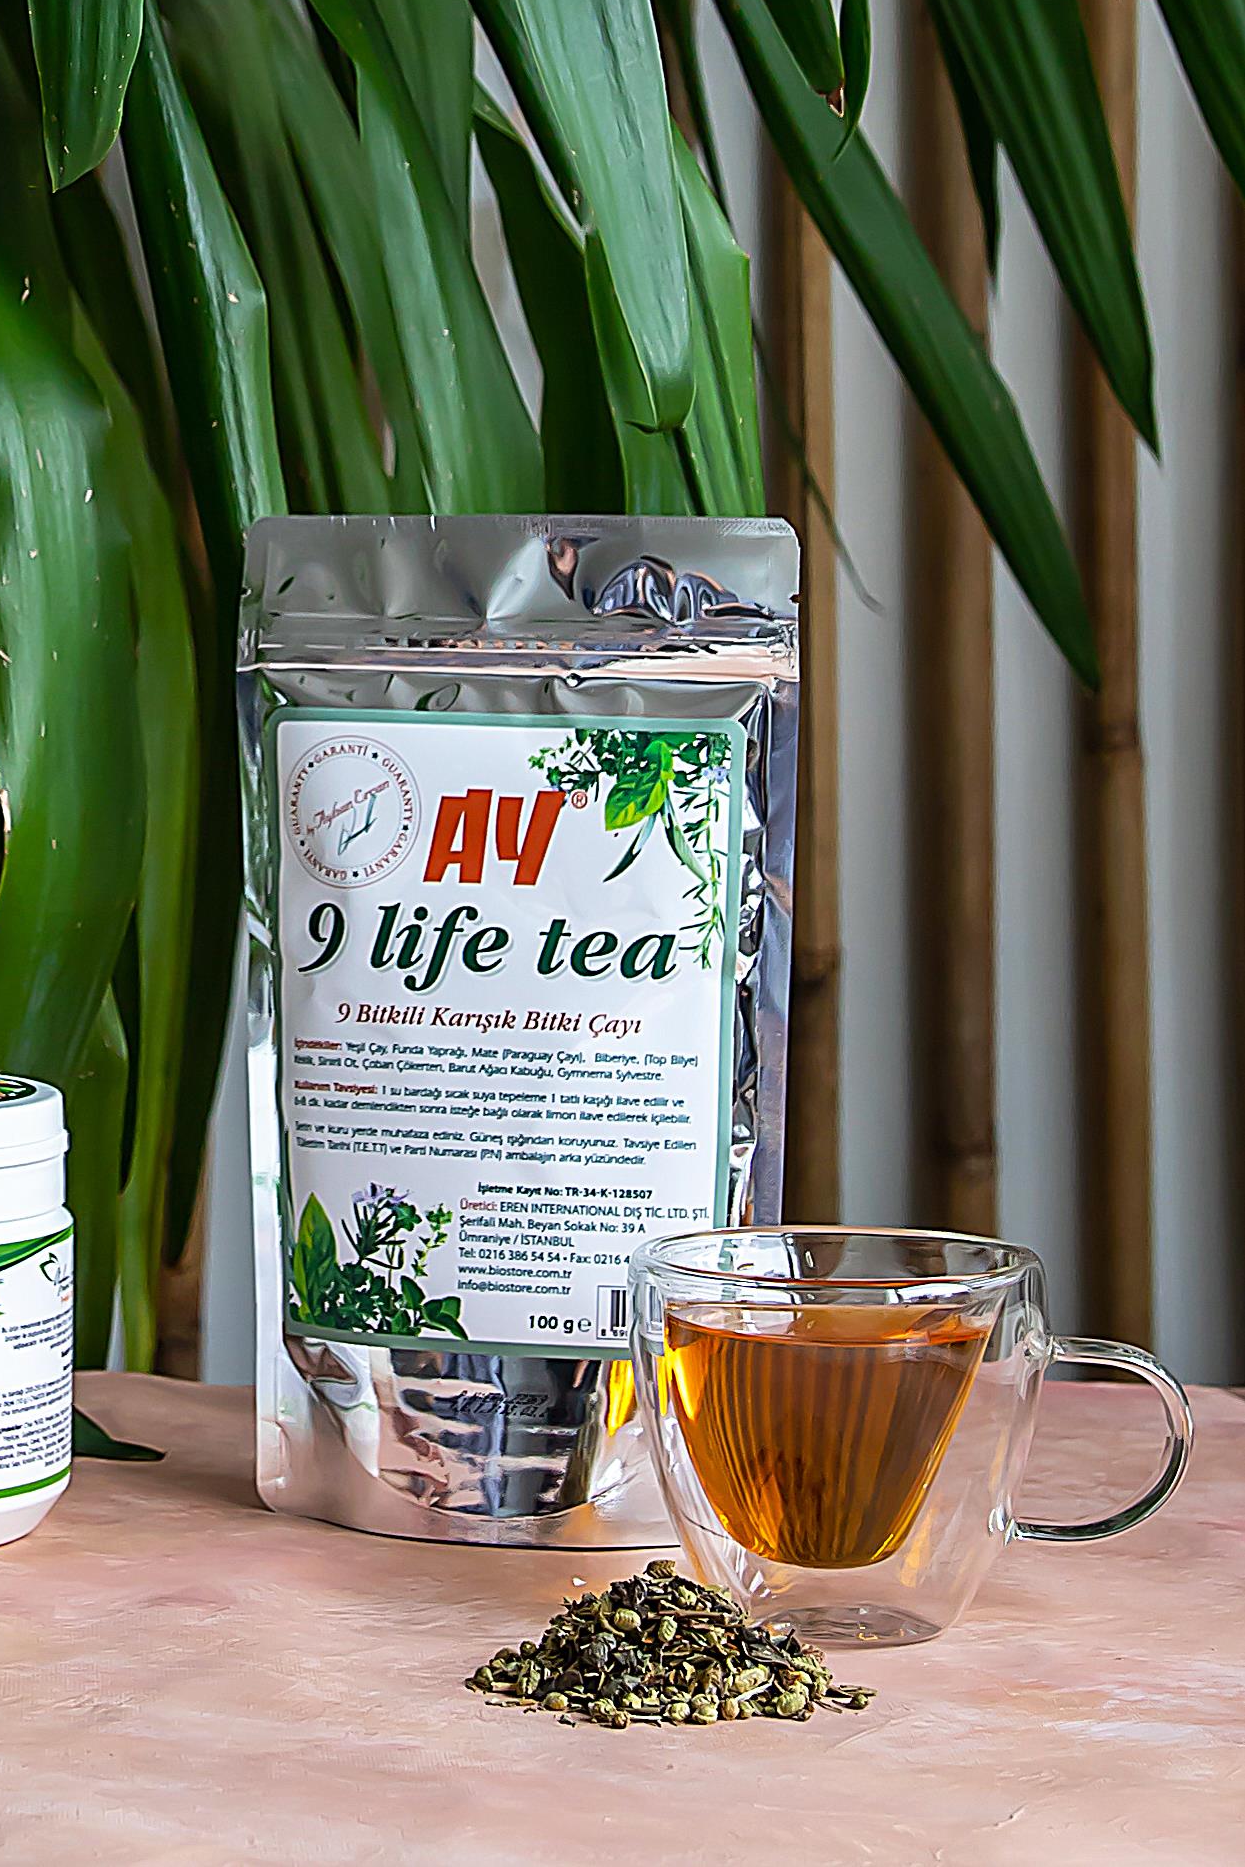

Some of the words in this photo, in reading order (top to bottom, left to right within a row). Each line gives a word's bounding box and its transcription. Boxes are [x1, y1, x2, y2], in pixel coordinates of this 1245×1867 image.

[423, 788, 567, 886] AY
[298, 902, 346, 974] 9
[369, 902, 510, 993] life
[536, 918, 680, 981] tea
[334, 1003, 351, 1023] 9
[356, 1004, 425, 1025] Bitkili
[430, 1006, 516, 1033] Karışık
[523, 1010, 582, 1032] Bitki
[588, 1013, 641, 1039] Çayı
[392, 1043, 424, 1054] Funda
[472, 1048, 499, 1058] Mate
[502, 1048, 553, 1063] (Paraguay
[362, 1058, 394, 1071] Çoban
[449, 1062, 476, 1073] Barut
[479, 1063, 507, 1077] Ağacı
[511, 1065, 553, 1079] Kabuğu,
[558, 1067, 612, 1080] Gymnema
[404, 1087, 442, 1100] bardağı
[473, 1091, 496, 1102] suya
[672, 1099, 684, 1107] ve
[419, 1105, 447, 1114] sonra
[511, 1108, 543, 1119] olarak
[546, 1109, 576, 1120] limon
[470, 1131, 503, 1146] Güneş
[623, 1138, 660, 1151] Tavsiye
[664, 1139, 696, 1150] Edilen
[389, 1146, 401, 1154] ve
[429, 1146, 477, 1158] Numarası
[559, 1153, 581, 1162] arka
[544, 1186, 563, 1196] No:
[565, 1186, 652, 1199] TR-34-K-128507
[500, 1201, 528, 1213] EREN
[531, 1203, 620, 1217] INTERNATIONAL
[624, 1206, 642, 1220] DIŞ
[668, 1208, 689, 1219] LTD.
[498, 1218, 524, 1229] Mah.
[527, 1219, 561, 1232] Beyan
[564, 1220, 597, 1232] Sokak
[600, 1222, 618, 1232] No:
[621, 1223, 635, 1233] 39
[638, 1224, 646, 1233] A
[459, 1230, 511, 1246] Ümraniye
[521, 1233, 574, 1247] İSTANBUL
[458, 1247, 476, 1258] Tel:
[478, 1249, 506, 1260] 0216
[509, 1250, 528, 1261] 386
[531, 1251, 544, 1262] 54
[547, 1252, 560, 1262] 54
[570, 1253, 591, 1264] Fax:
[594, 1254, 621, 1264] 0216
[458, 1265, 572, 1279] www.biostore.com.tr
[457, 1279, 571, 1295] info@biostore.com.tr
[529, 1315, 558, 1330] 100
